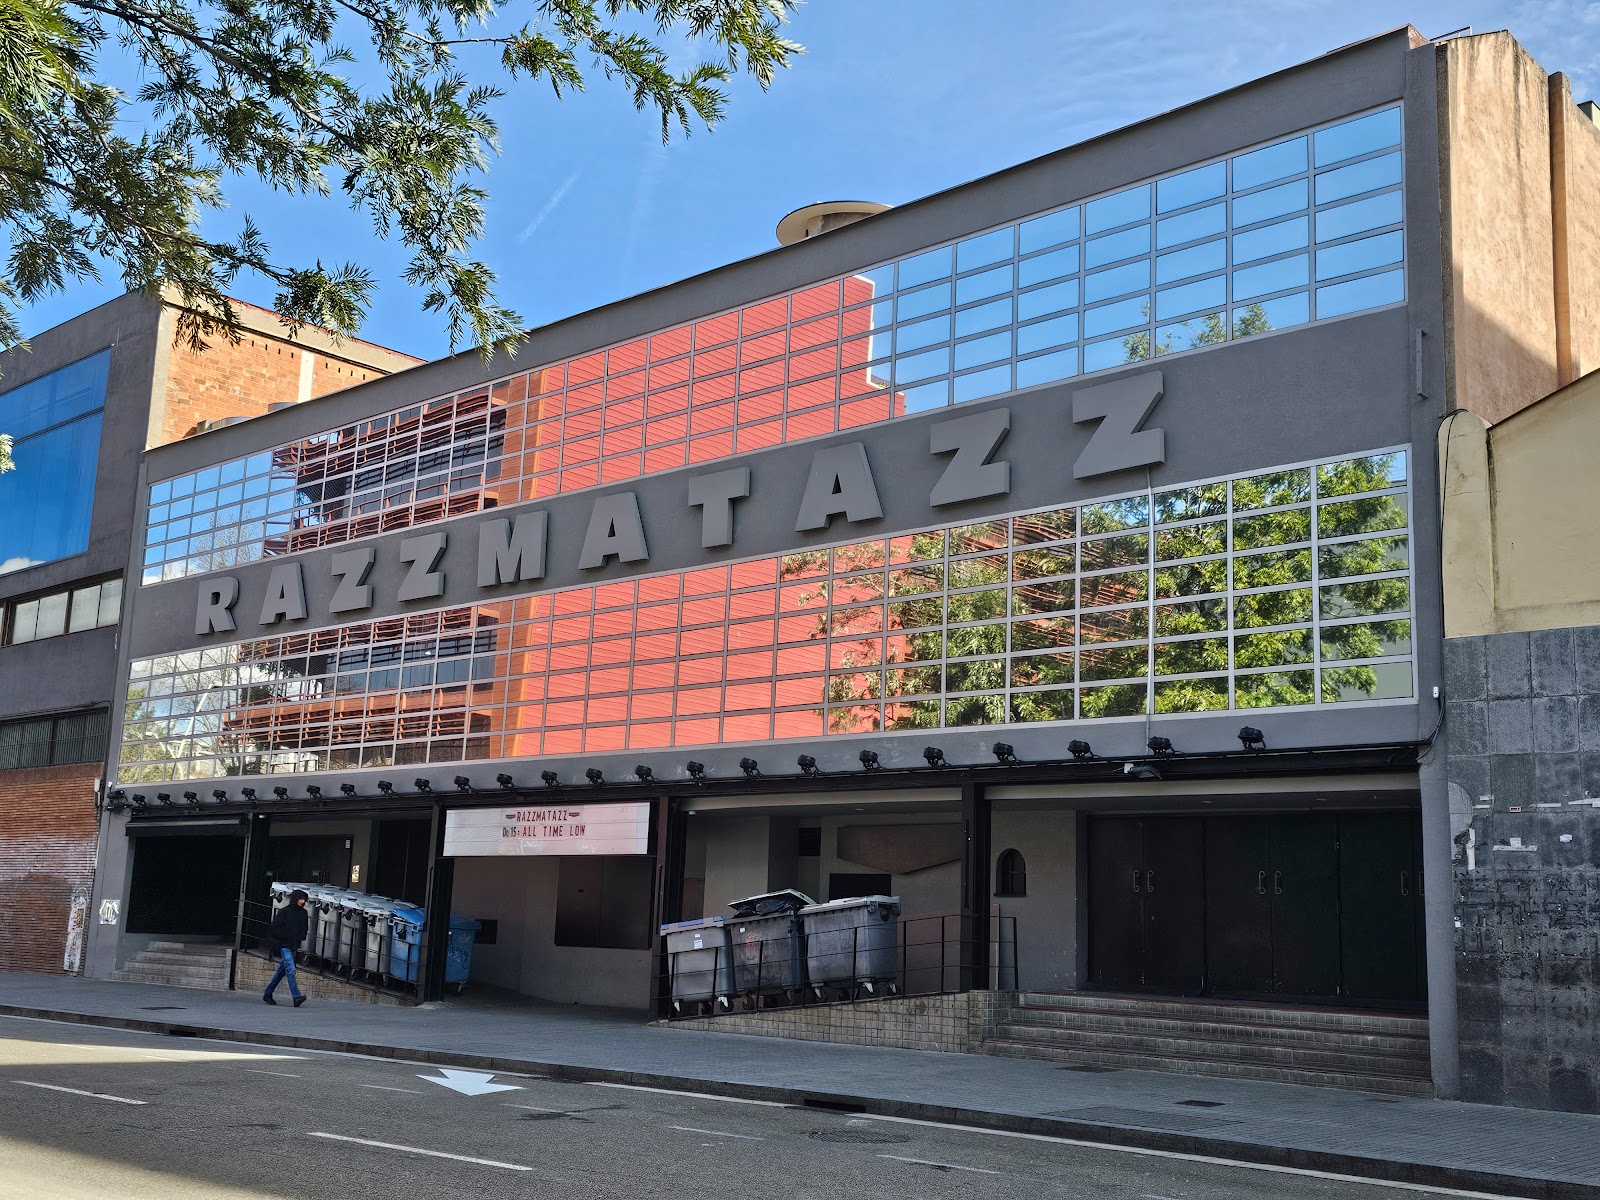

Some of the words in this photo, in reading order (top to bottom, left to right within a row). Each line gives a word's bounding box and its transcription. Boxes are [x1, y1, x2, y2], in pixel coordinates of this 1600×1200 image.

[195, 370, 1166, 635] RAZZMATAZZ
[516, 809, 567, 822] RAZZMATAZZ
[522, 826, 537, 837] ALL
[543, 825, 564, 837] TIME
[569, 824, 586, 836] LOW
